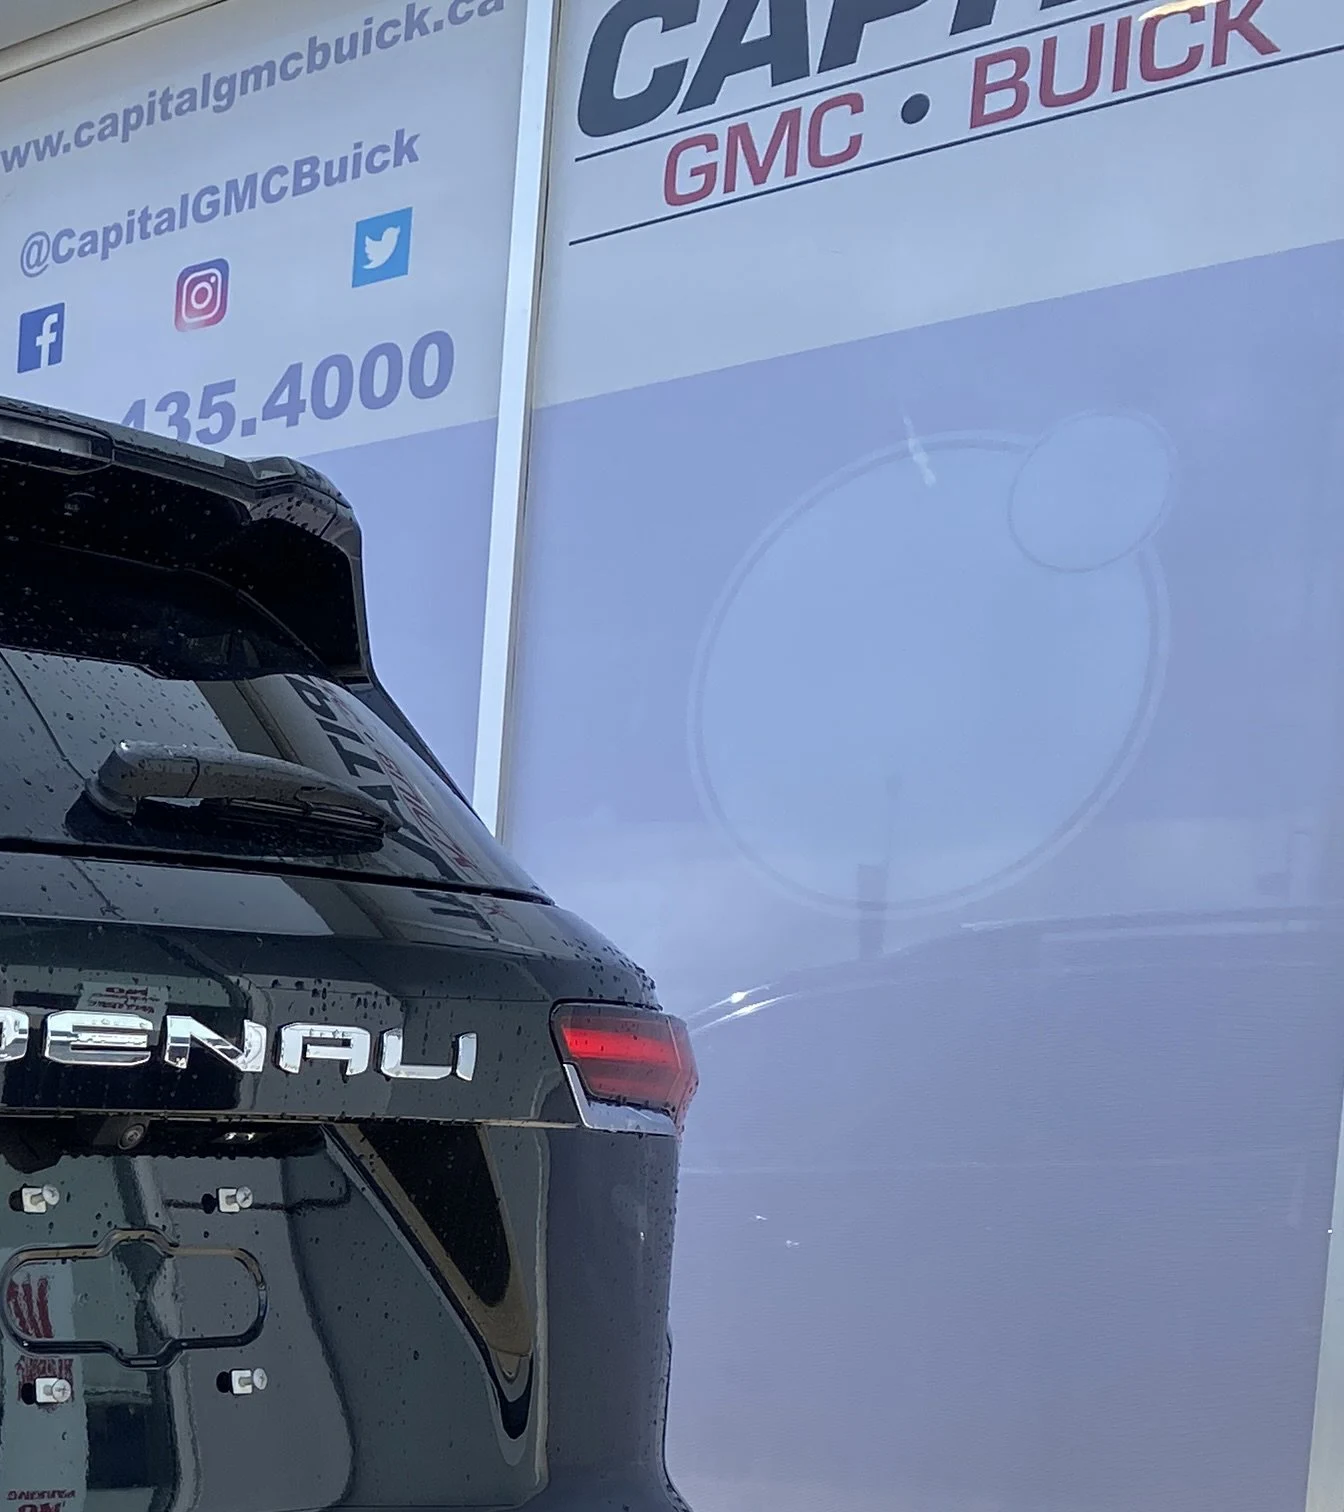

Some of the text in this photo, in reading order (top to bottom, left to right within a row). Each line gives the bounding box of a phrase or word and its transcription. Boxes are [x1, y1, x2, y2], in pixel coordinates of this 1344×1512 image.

[662, 0, 1282, 207] GMC BUICK
[20, 128, 422, 278] @CapitalGMCBuick
